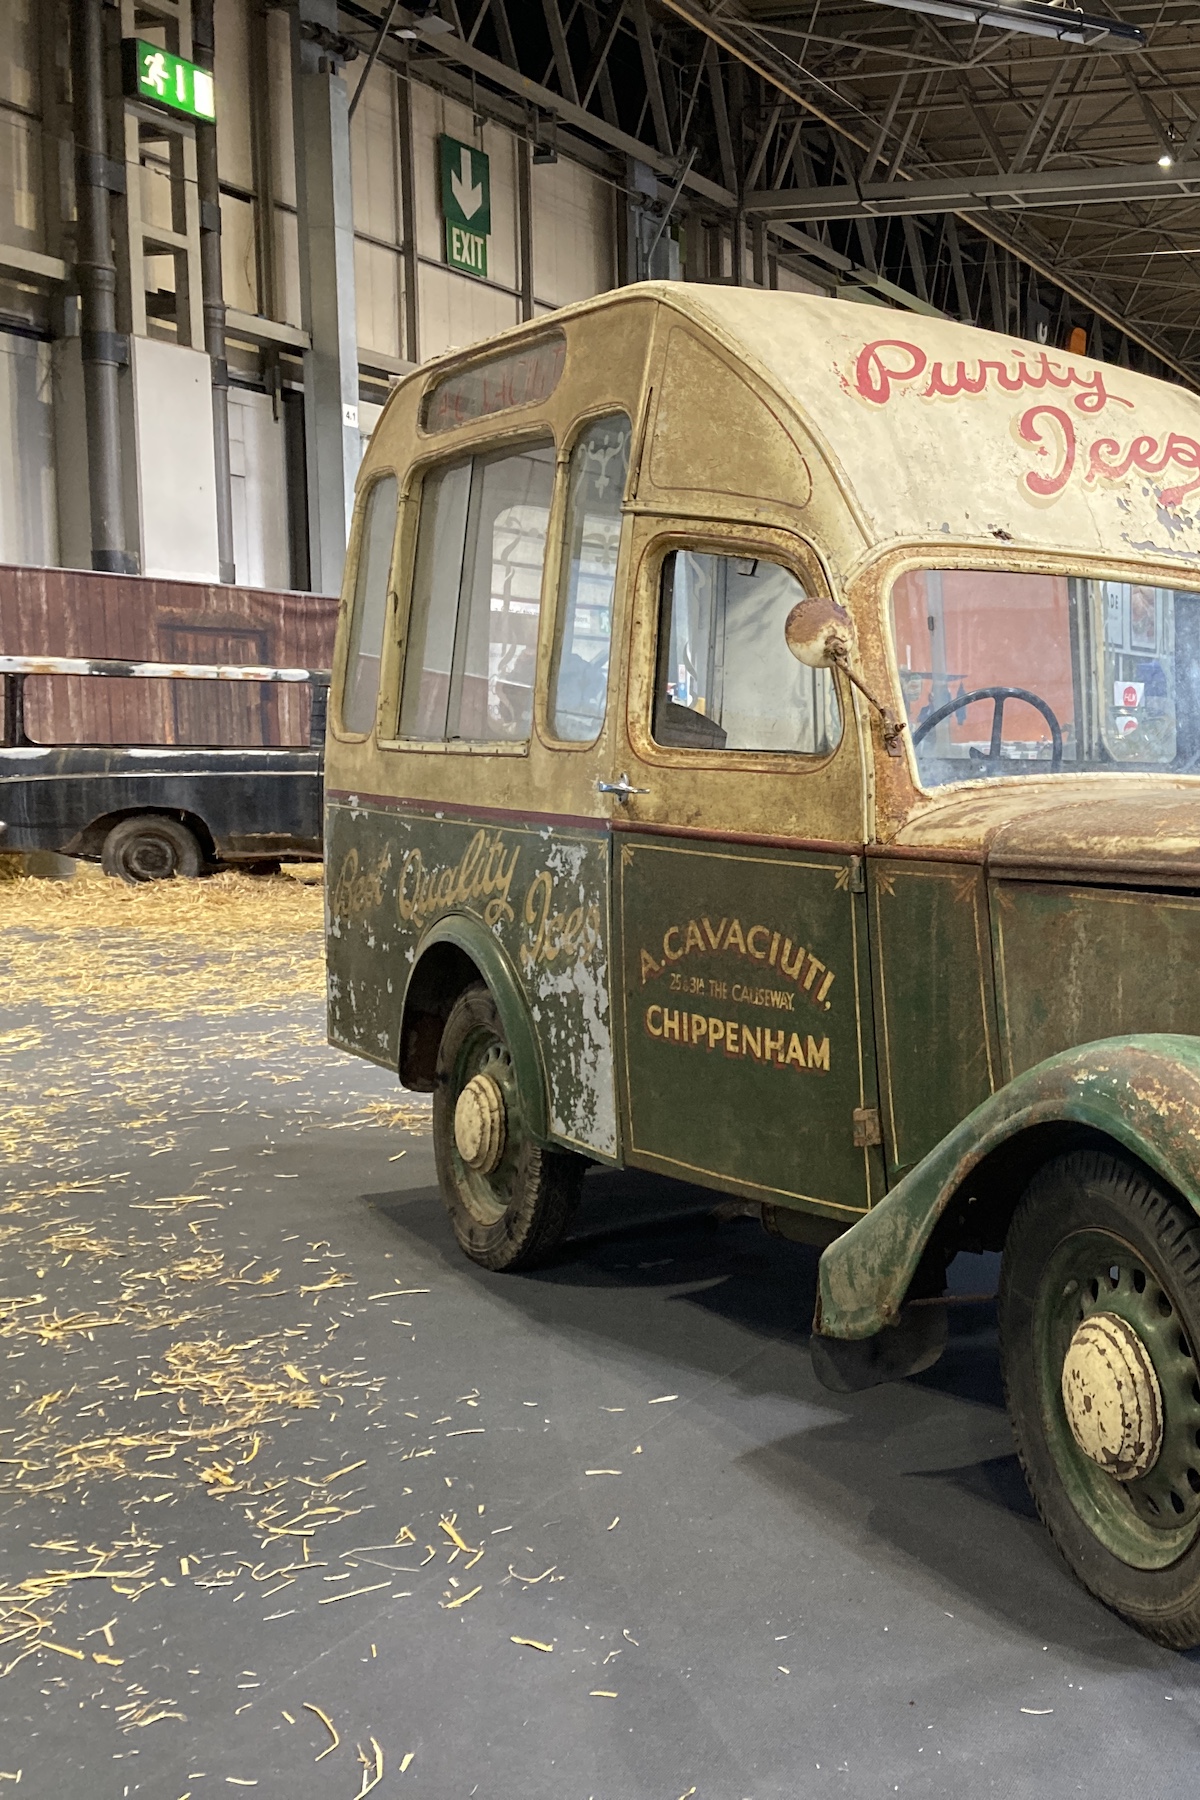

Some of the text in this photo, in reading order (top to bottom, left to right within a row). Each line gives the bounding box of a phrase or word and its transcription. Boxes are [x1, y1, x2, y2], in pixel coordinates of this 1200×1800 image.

[452, 227, 484, 269] EXIT
[855, 339, 1135, 413] Purity
[334, 829, 601, 966] Best Quality Ices
[709, 980, 728, 999] THE
[646, 1004, 831, 1072] CHIPPENHAM
